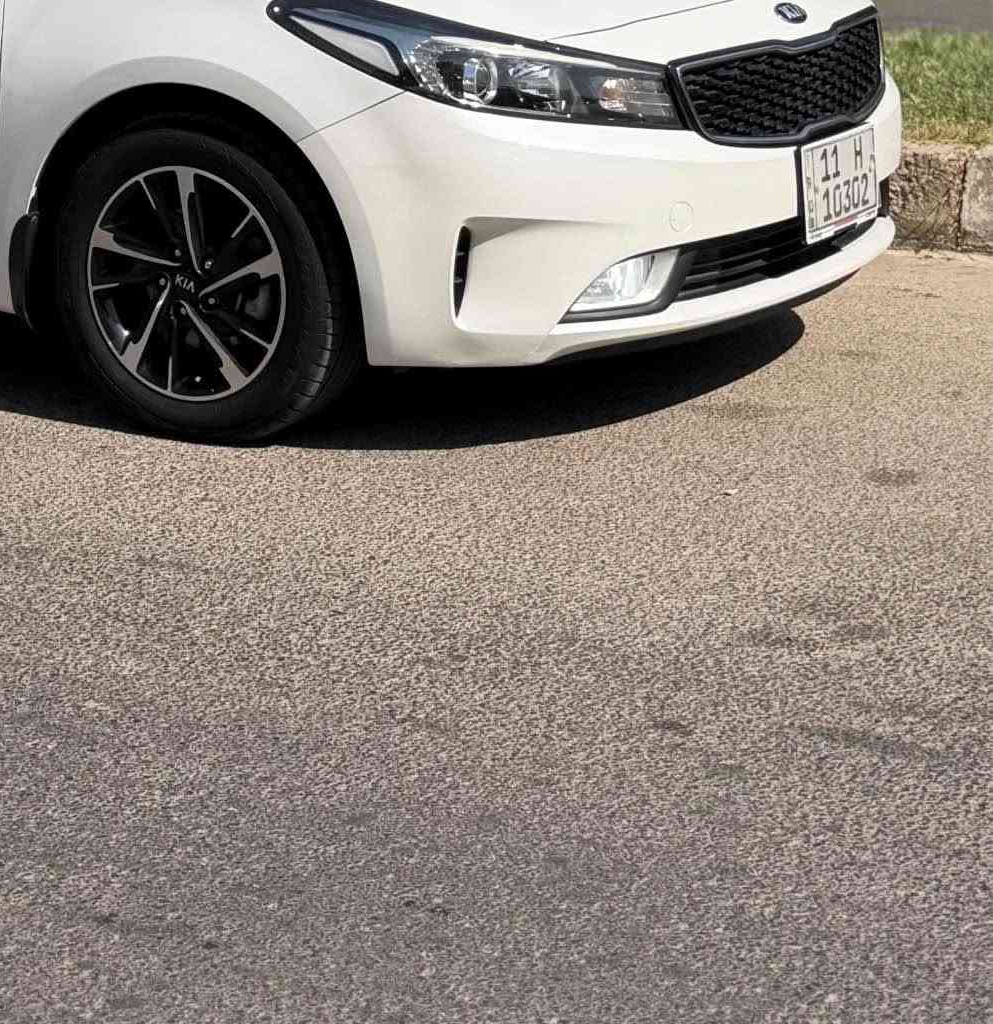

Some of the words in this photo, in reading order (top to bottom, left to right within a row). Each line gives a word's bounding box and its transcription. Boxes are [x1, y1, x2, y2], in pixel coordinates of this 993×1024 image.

[820, 144, 840, 183] 11
[854, 135, 863, 171] H
[822, 173, 869, 222] 10302
[175, 274, 195, 293] KIA
